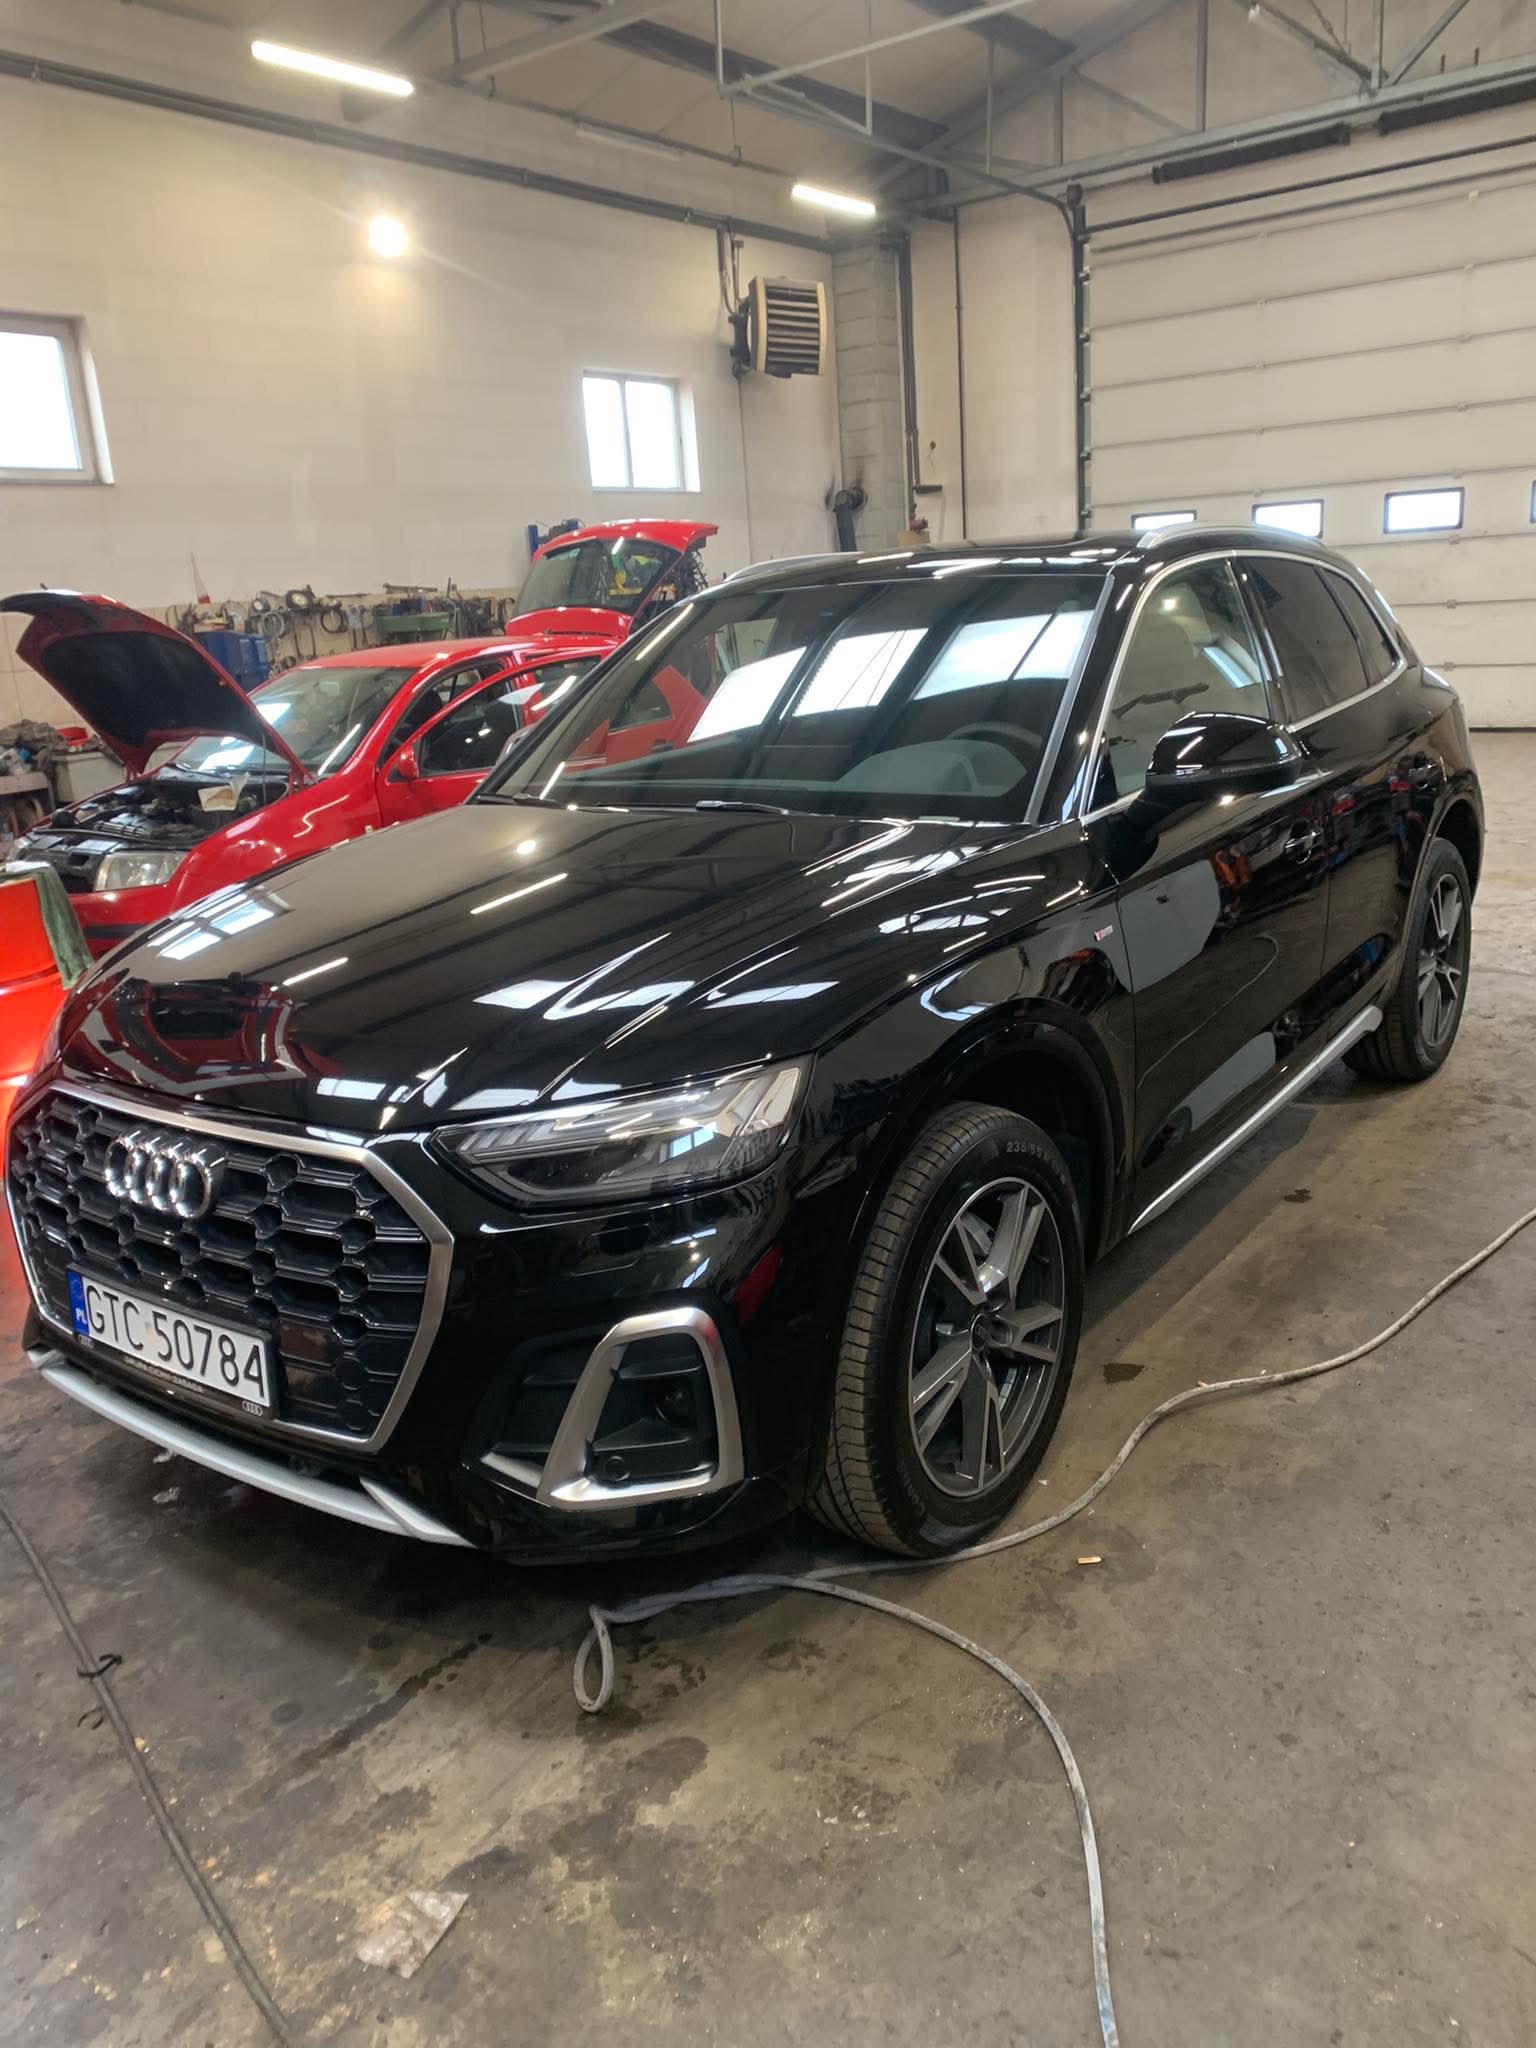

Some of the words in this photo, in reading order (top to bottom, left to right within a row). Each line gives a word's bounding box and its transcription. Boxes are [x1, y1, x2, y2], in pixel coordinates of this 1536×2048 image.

[75, 1309, 88, 1325] PL
[86, 1285, 145, 1352] GTC
[153, 1313, 265, 1398] 50784
